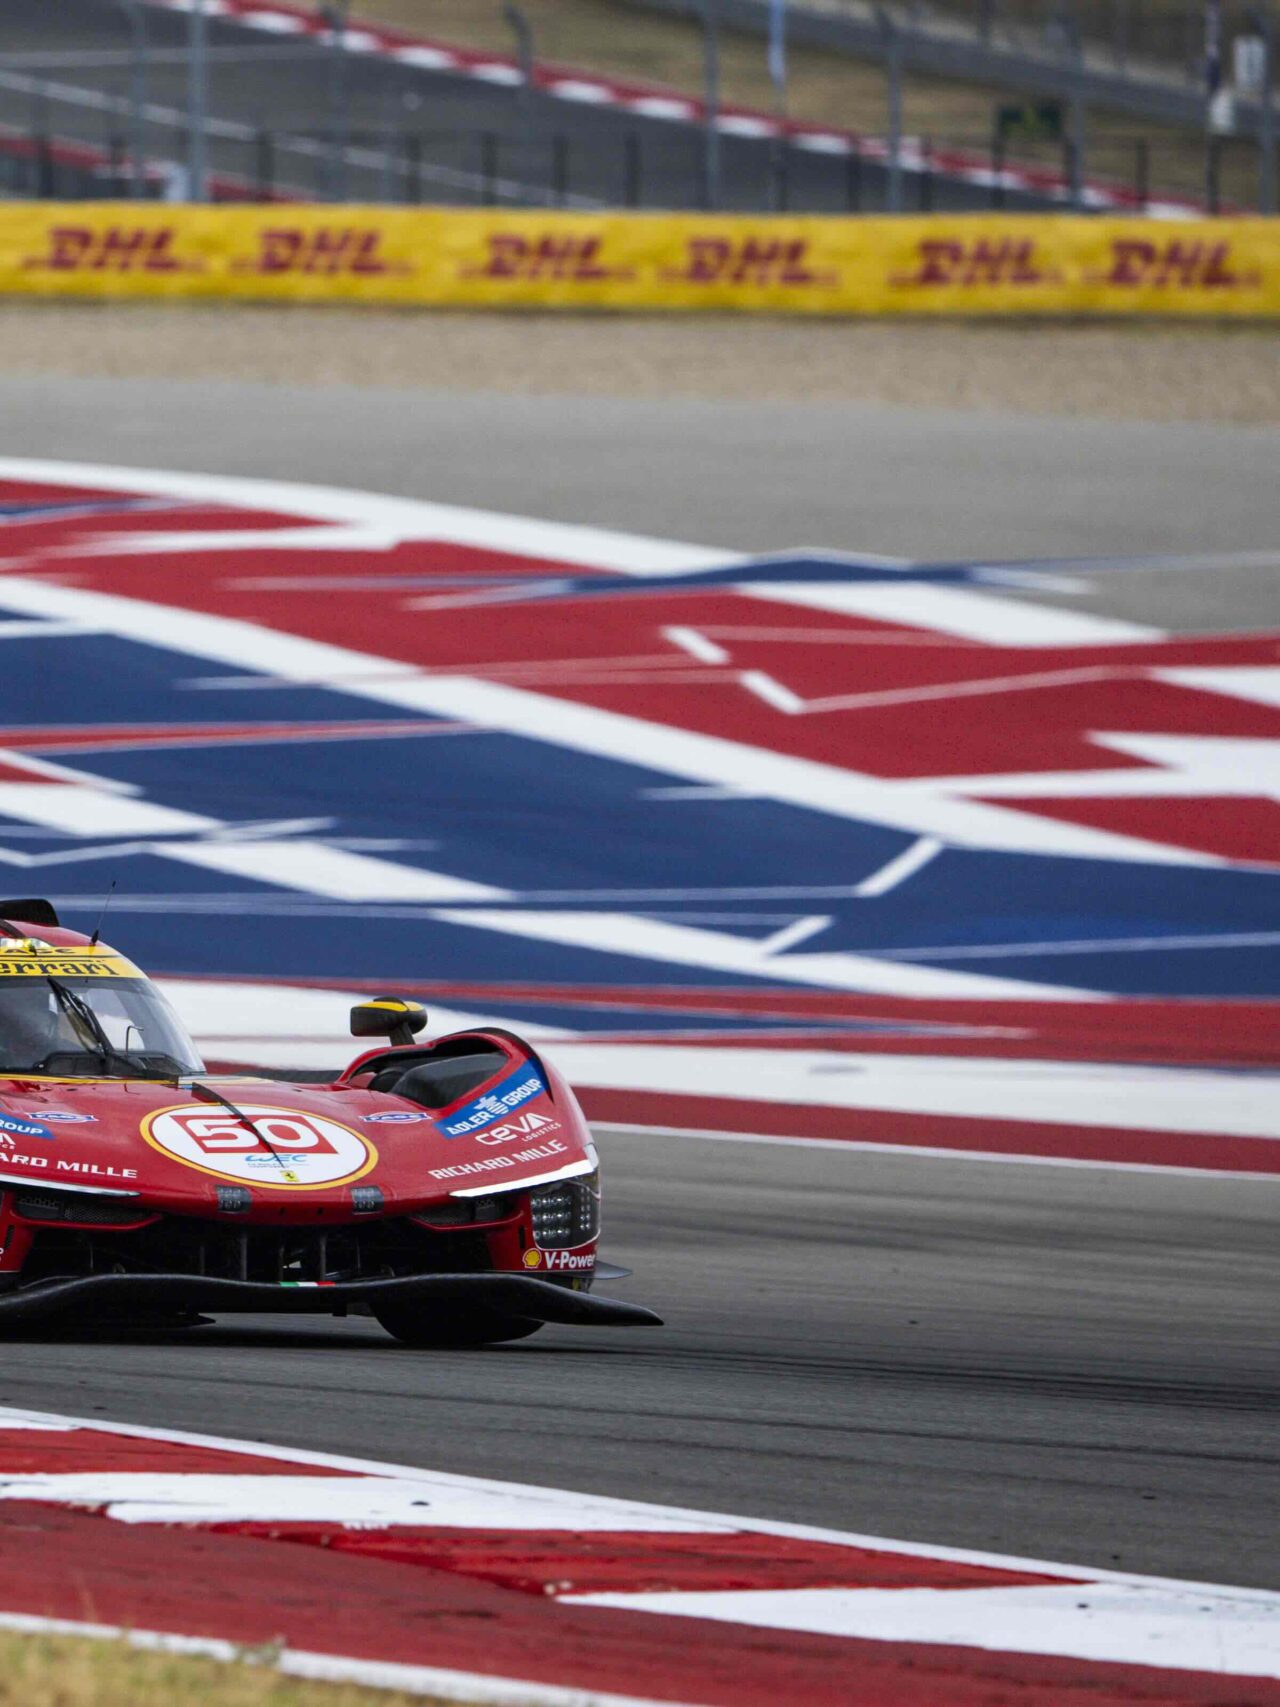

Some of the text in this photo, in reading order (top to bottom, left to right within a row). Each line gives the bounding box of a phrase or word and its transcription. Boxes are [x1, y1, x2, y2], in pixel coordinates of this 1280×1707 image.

[48, 227, 180, 273] DHL
[260, 230, 384, 275] DHL
[487, 235, 607, 280] DHL
[688, 238, 813, 285] DHL
[918, 239, 1042, 287] DHL
[1110, 239, 1237, 288] DHL
[445, 1077, 543, 1135] ADLER GROUP
[186, 1118, 319, 1148] 50
[521, 1122, 562, 1142] LOGISTICS
[57, 1159, 138, 1179] MILLE
[428, 1139, 568, 1180] RICHARD MILLE
